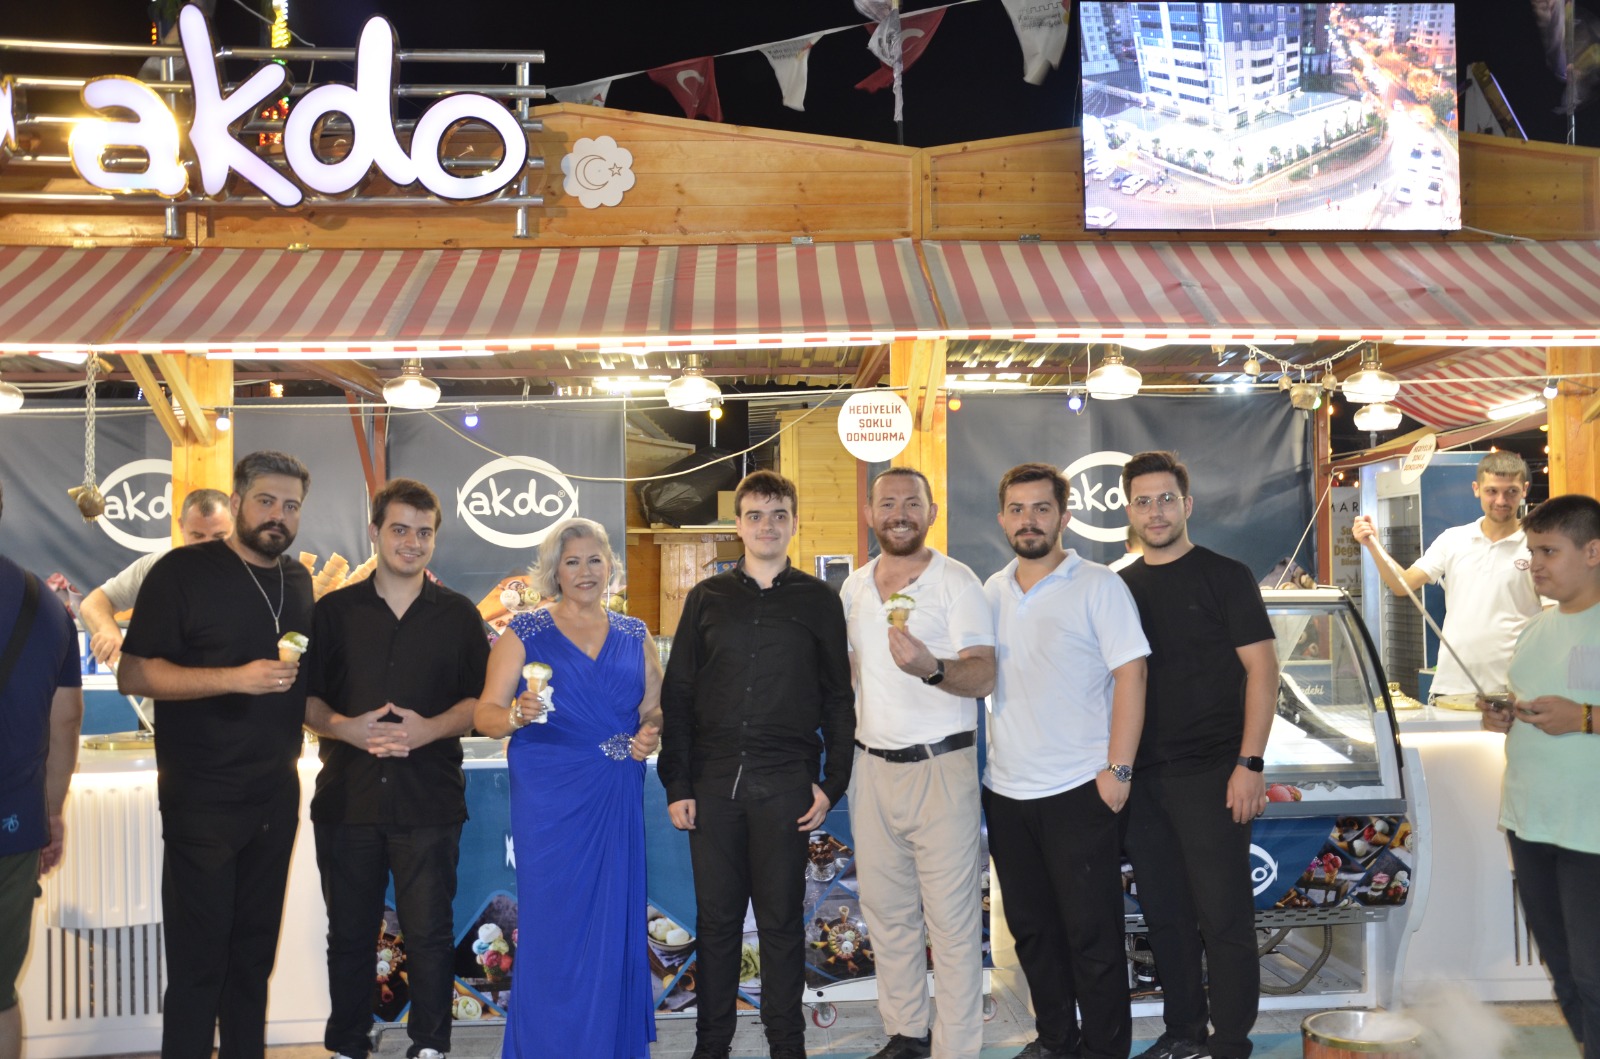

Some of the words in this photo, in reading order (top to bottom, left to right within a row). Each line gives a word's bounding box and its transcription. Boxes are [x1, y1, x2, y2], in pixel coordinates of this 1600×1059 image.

[69, 2, 528, 207] akdo
[848, 402, 902, 415] HEDİYELİK
[846, 432, 905, 442] DONDURMA
[858, 418, 893, 431] ŞOKLU
[104, 481, 172, 522] akd
[1066, 472, 1129, 512] akd
